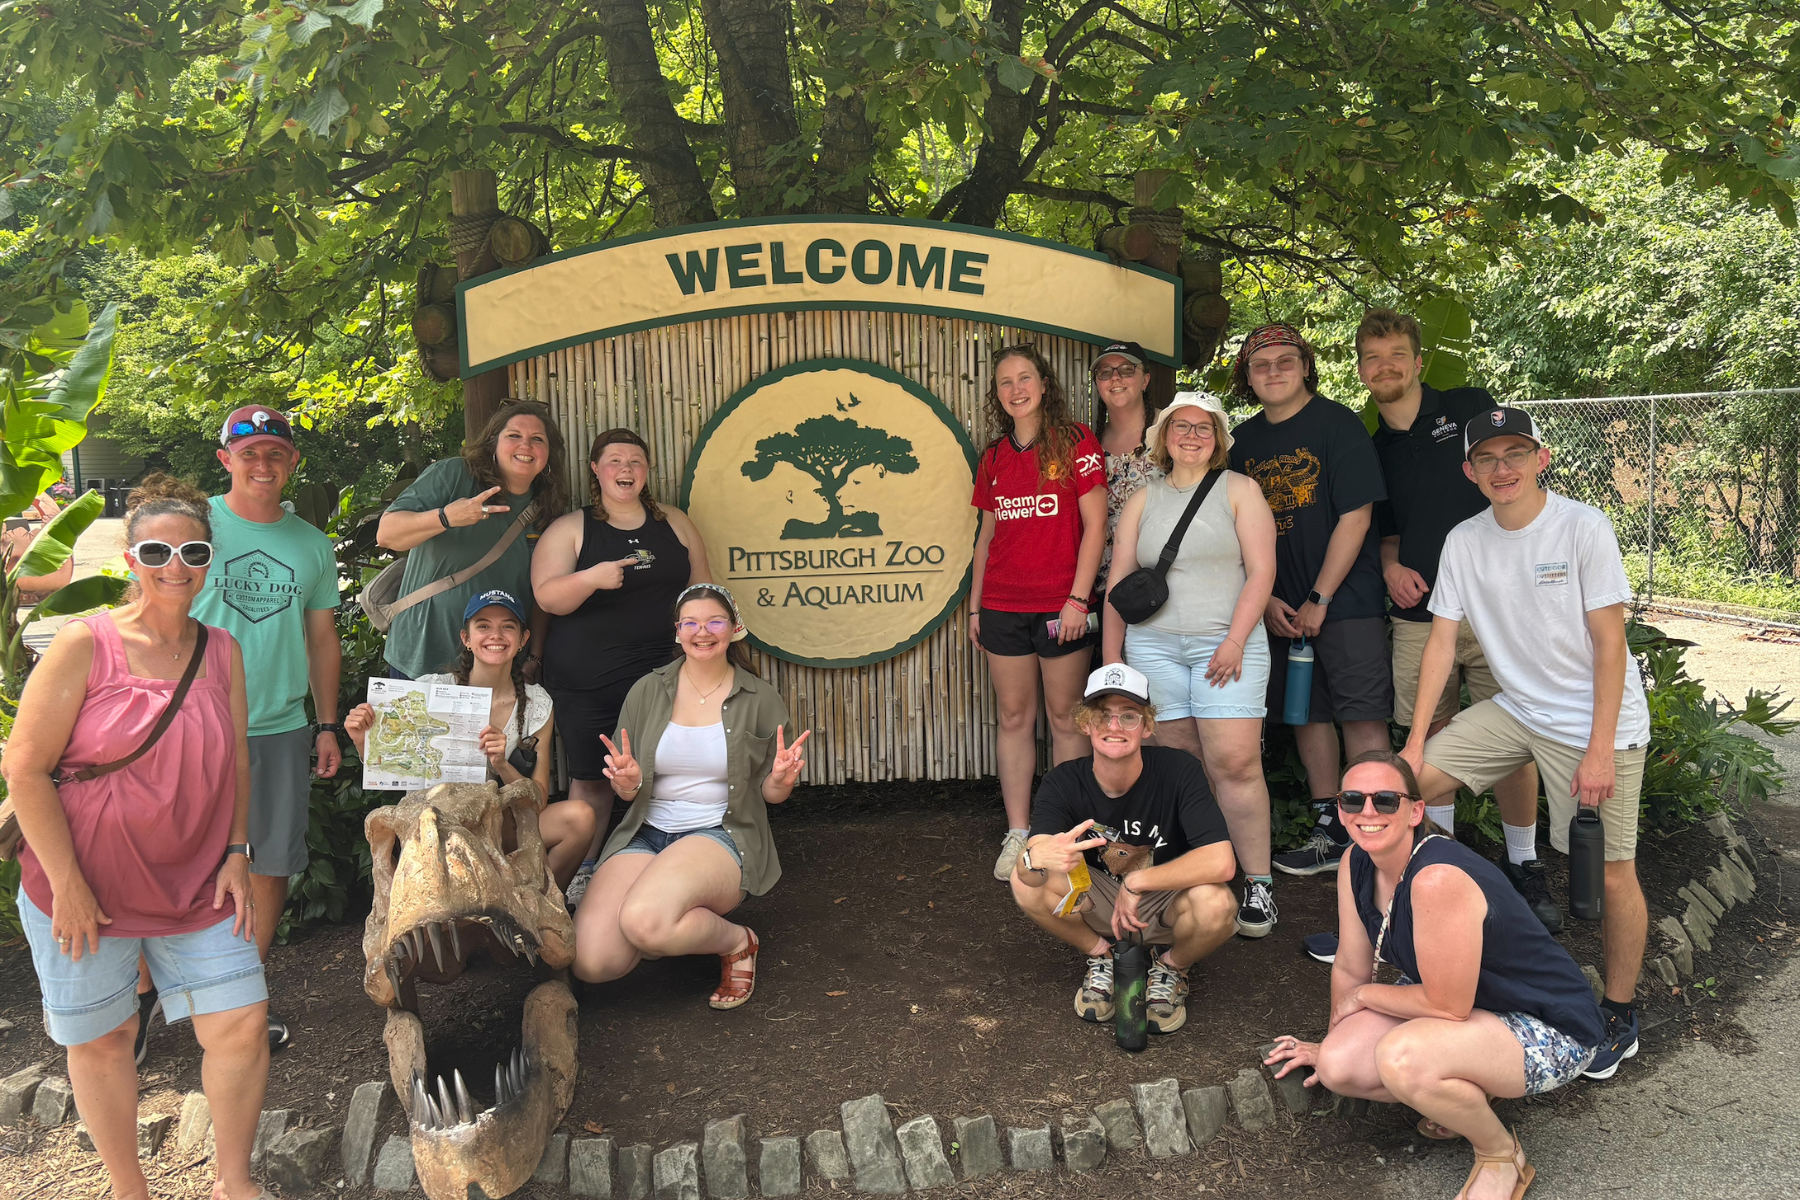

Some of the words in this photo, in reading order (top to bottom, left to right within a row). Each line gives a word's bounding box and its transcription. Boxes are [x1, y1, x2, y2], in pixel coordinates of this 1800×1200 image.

[665, 238, 989, 296] WELCOME
[1431, 422, 1458, 436] GENEVA
[994, 495, 1035, 509] Team
[728, 546, 876, 572] PITTSBURGH
[885, 540, 945, 566] ZOO
[214, 577, 263, 593] LUCKY
[269, 583, 303, 596] DOG
[756, 587, 776, 607] &
[781, 581, 924, 610] AQUARIUM
[235, 594, 256, 603] CUSTOM
[256, 596, 280, 604] APPAREL
[1123, 819, 1142, 836] IS
